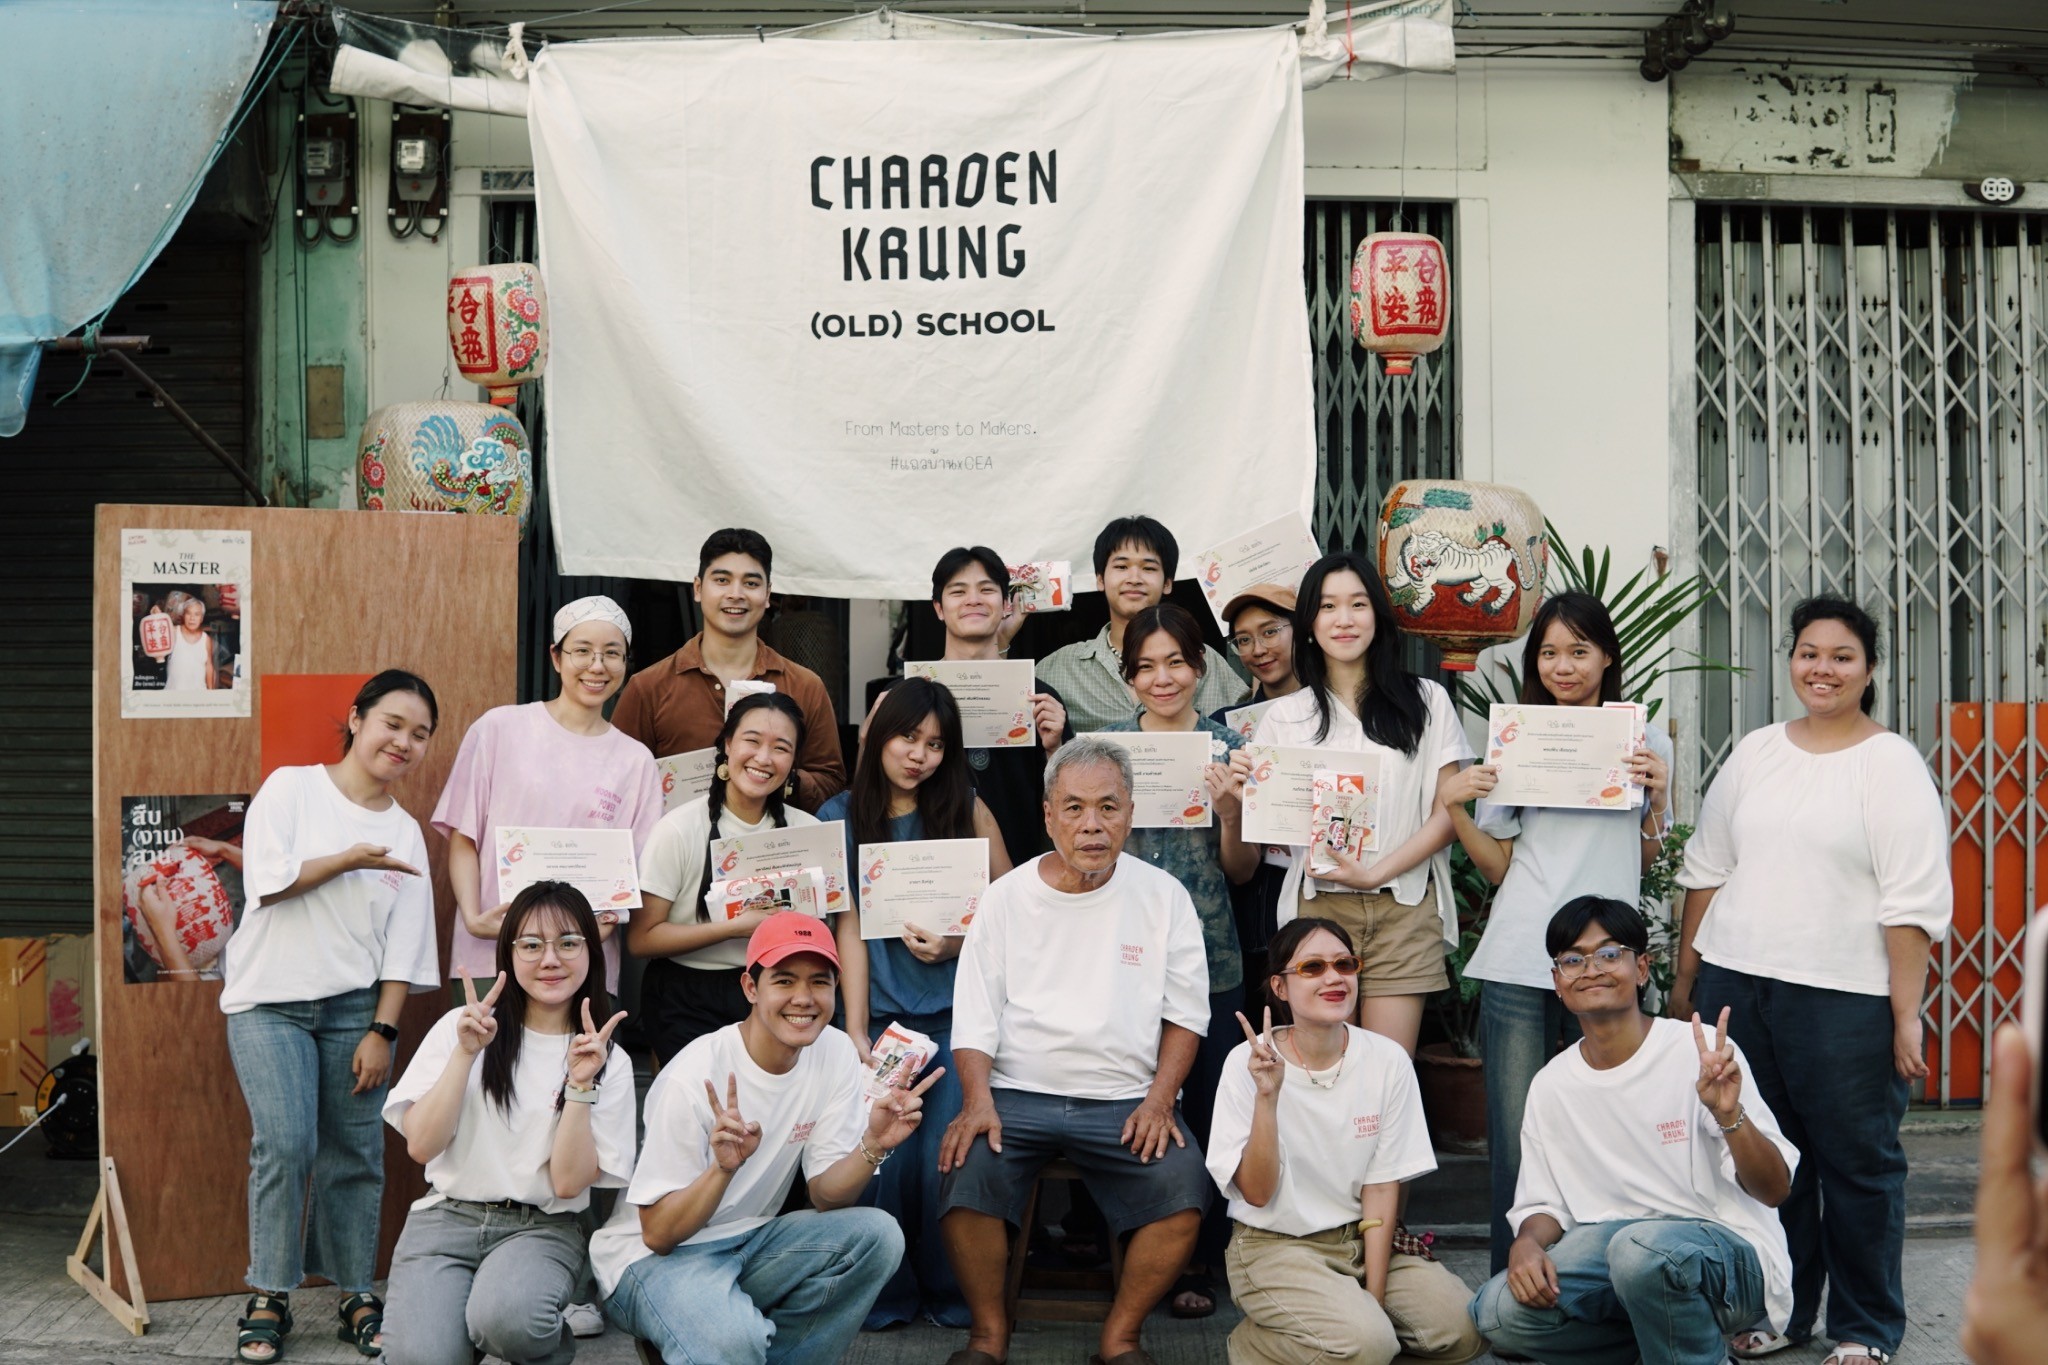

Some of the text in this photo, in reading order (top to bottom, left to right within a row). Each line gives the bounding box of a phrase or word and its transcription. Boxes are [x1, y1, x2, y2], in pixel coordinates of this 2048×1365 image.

[811, 148, 1057, 210] CHAROEN
[843, 223, 1026, 282] KRUNG
[811, 309, 1056, 340] (OLD) SCHOOL
[845, 420, 1037, 436] From Masters to Makers.
[179, 552, 195, 560] THE
[153, 562, 220, 575] MASTER
[132, 826, 184, 847] (งาน)
